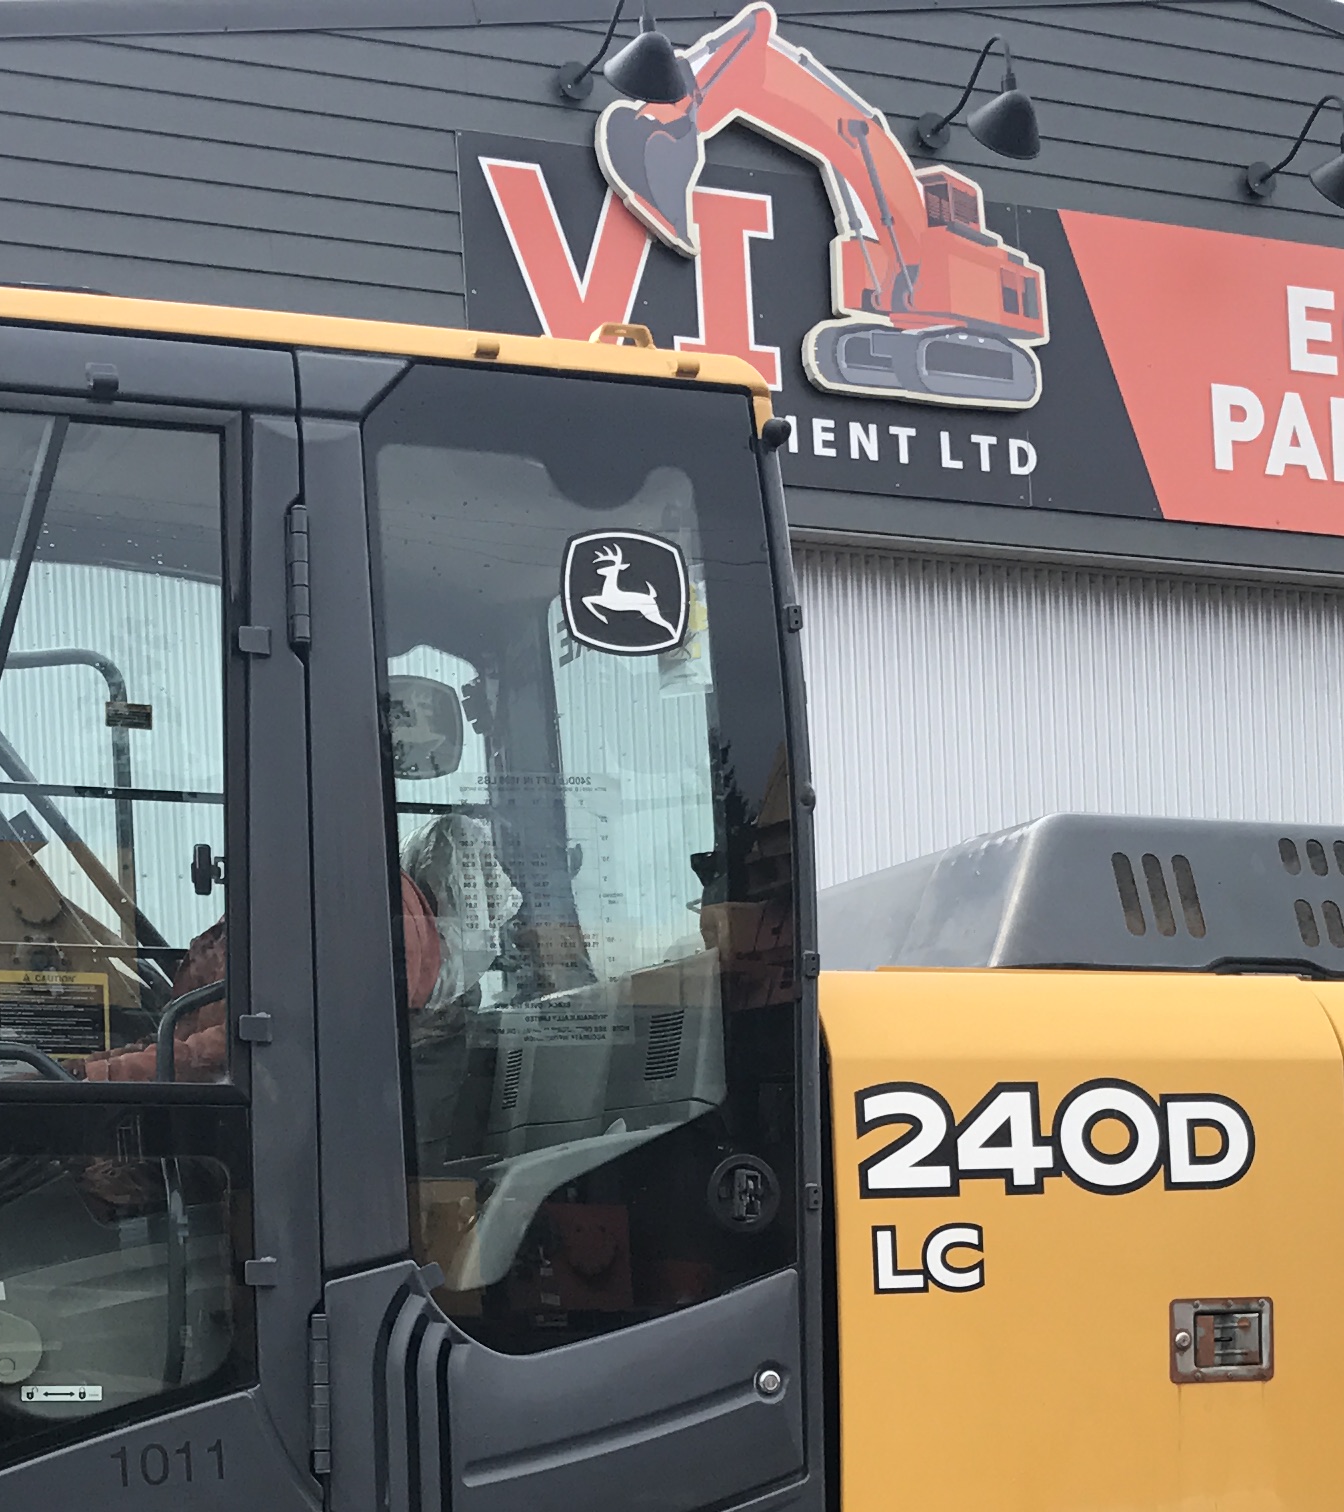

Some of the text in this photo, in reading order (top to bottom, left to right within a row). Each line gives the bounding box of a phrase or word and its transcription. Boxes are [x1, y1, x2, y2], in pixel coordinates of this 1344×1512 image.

[940, 431, 1037, 475] LTD
[35, 974, 76, 982] CAUTION
[855, 1077, 1256, 1199] 240D
[871, 1223, 985, 1294] LC
[110, 1438, 225, 1487] 1011
